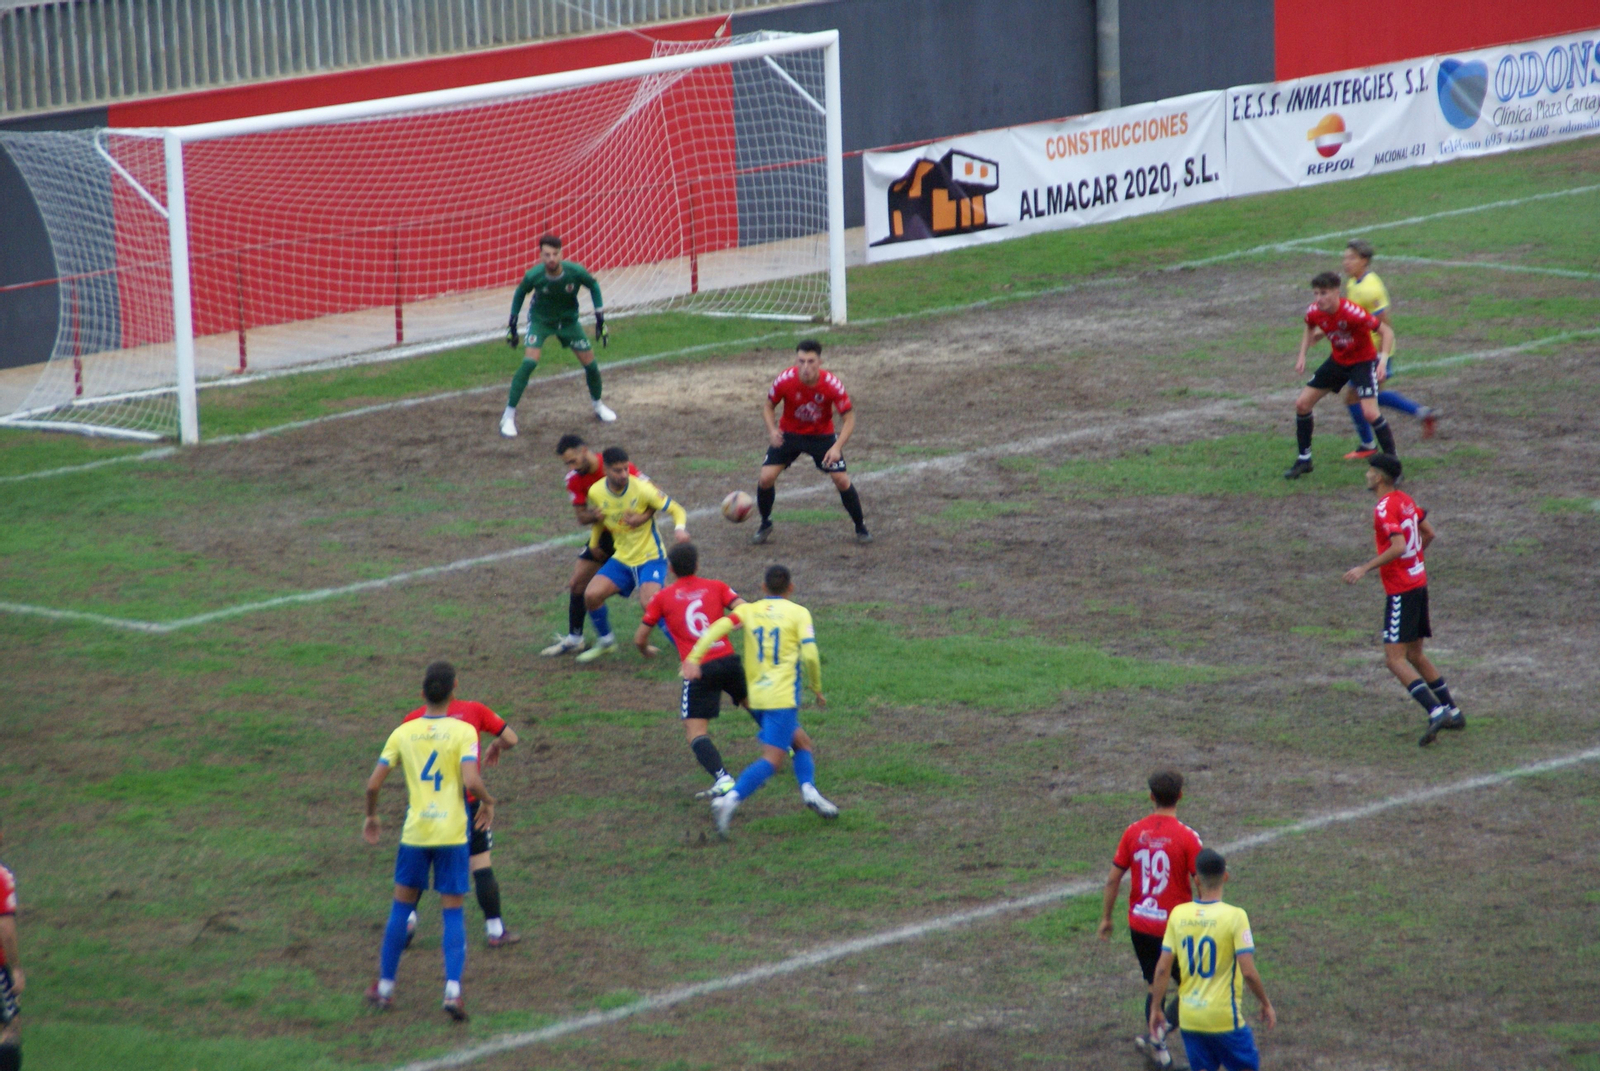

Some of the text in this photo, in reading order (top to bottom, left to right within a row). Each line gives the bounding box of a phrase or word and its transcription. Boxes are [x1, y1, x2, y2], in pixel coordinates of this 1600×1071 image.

[1232, 66, 1429, 121] E.E.S.S. INMATERGIES, S.L.
[1493, 105, 1532, 127] Clínica
[1535, 99, 1563, 120] Plaza
[1046, 111, 1188, 160] CONSTRUCCIONES
[1374, 142, 1426, 165] NACIONAL 431
[1439, 138, 1481, 155] Teléfono
[1020, 153, 1219, 221] ALMACAR 2020, S.L.
[1307, 158, 1355, 176] REPSOL
[685, 599, 710, 639] 6
[753, 626, 780, 665] 11
[420, 749, 443, 791] 4
[1133, 849, 1170, 895] 19
[1182, 935, 1217, 978] 10
